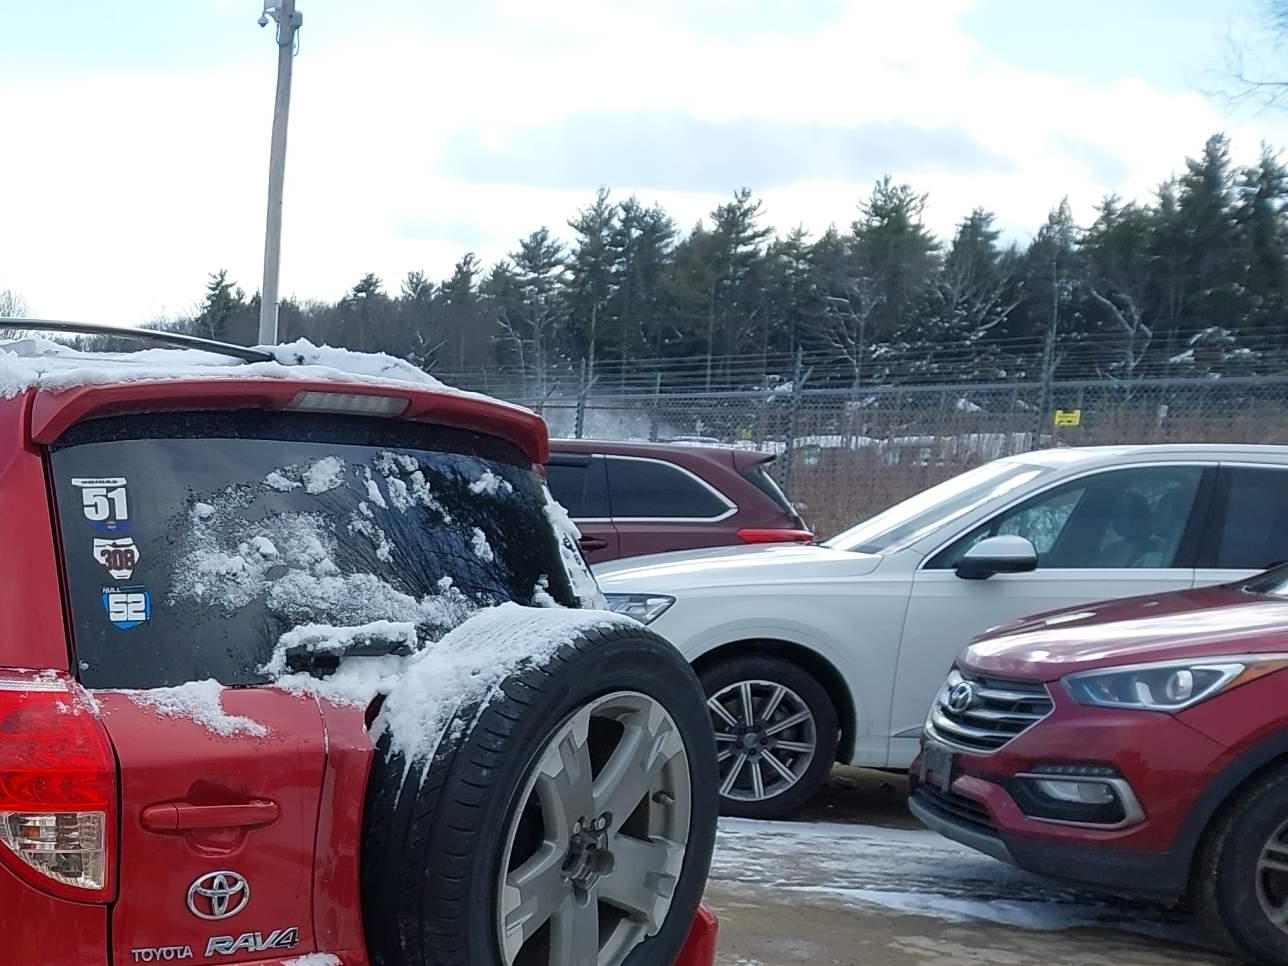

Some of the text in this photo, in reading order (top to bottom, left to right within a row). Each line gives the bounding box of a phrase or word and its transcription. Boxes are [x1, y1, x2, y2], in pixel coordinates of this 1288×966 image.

[82, 487, 128, 520] 51
[100, 548, 135, 571] 308
[108, 593, 146, 621] 52
[131, 926, 300, 962] TOYOTA RAV4
